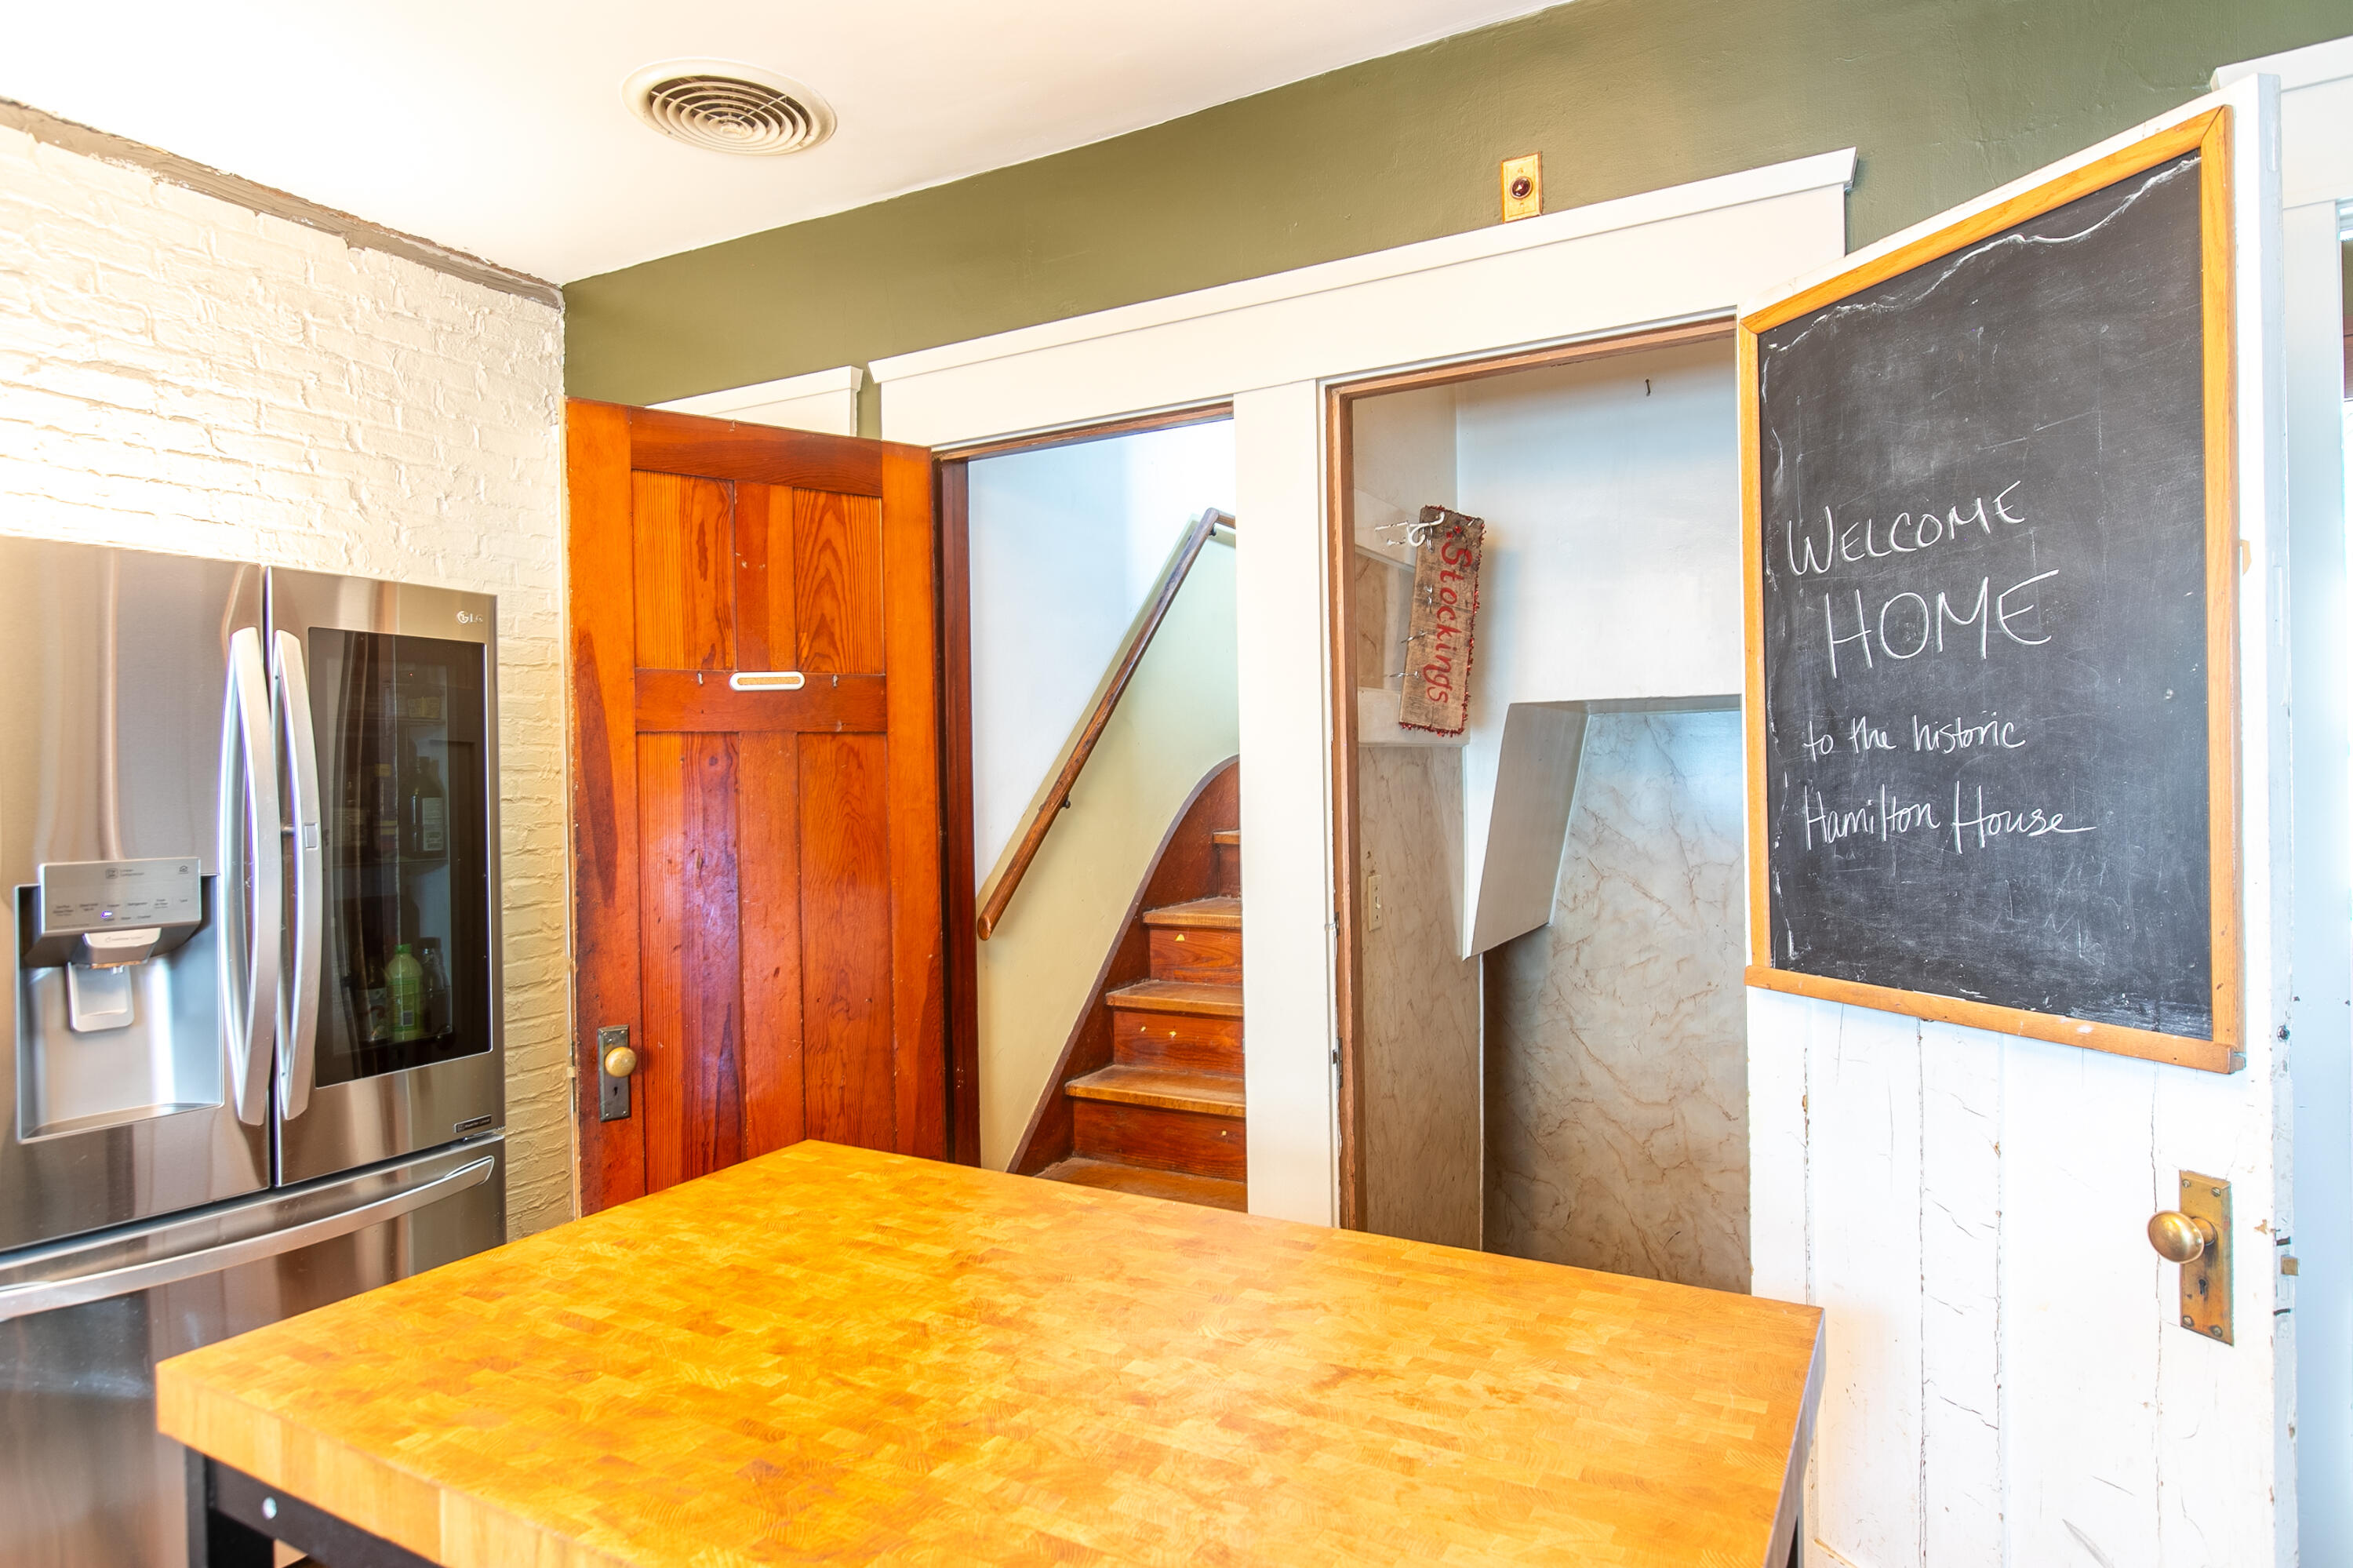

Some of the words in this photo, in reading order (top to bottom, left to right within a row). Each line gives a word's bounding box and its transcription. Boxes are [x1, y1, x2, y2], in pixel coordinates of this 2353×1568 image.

[1787, 480, 2025, 576] WELCOME
[1423, 541, 1474, 704] Stockings
[1824, 569, 2060, 678] HOME
[1803, 720, 1834, 762] to
[1848, 715, 1897, 754] the
[1912, 711, 2026, 753] historic
[1804, 784, 1941, 851] Hamilton
[1951, 780, 2097, 854] House
